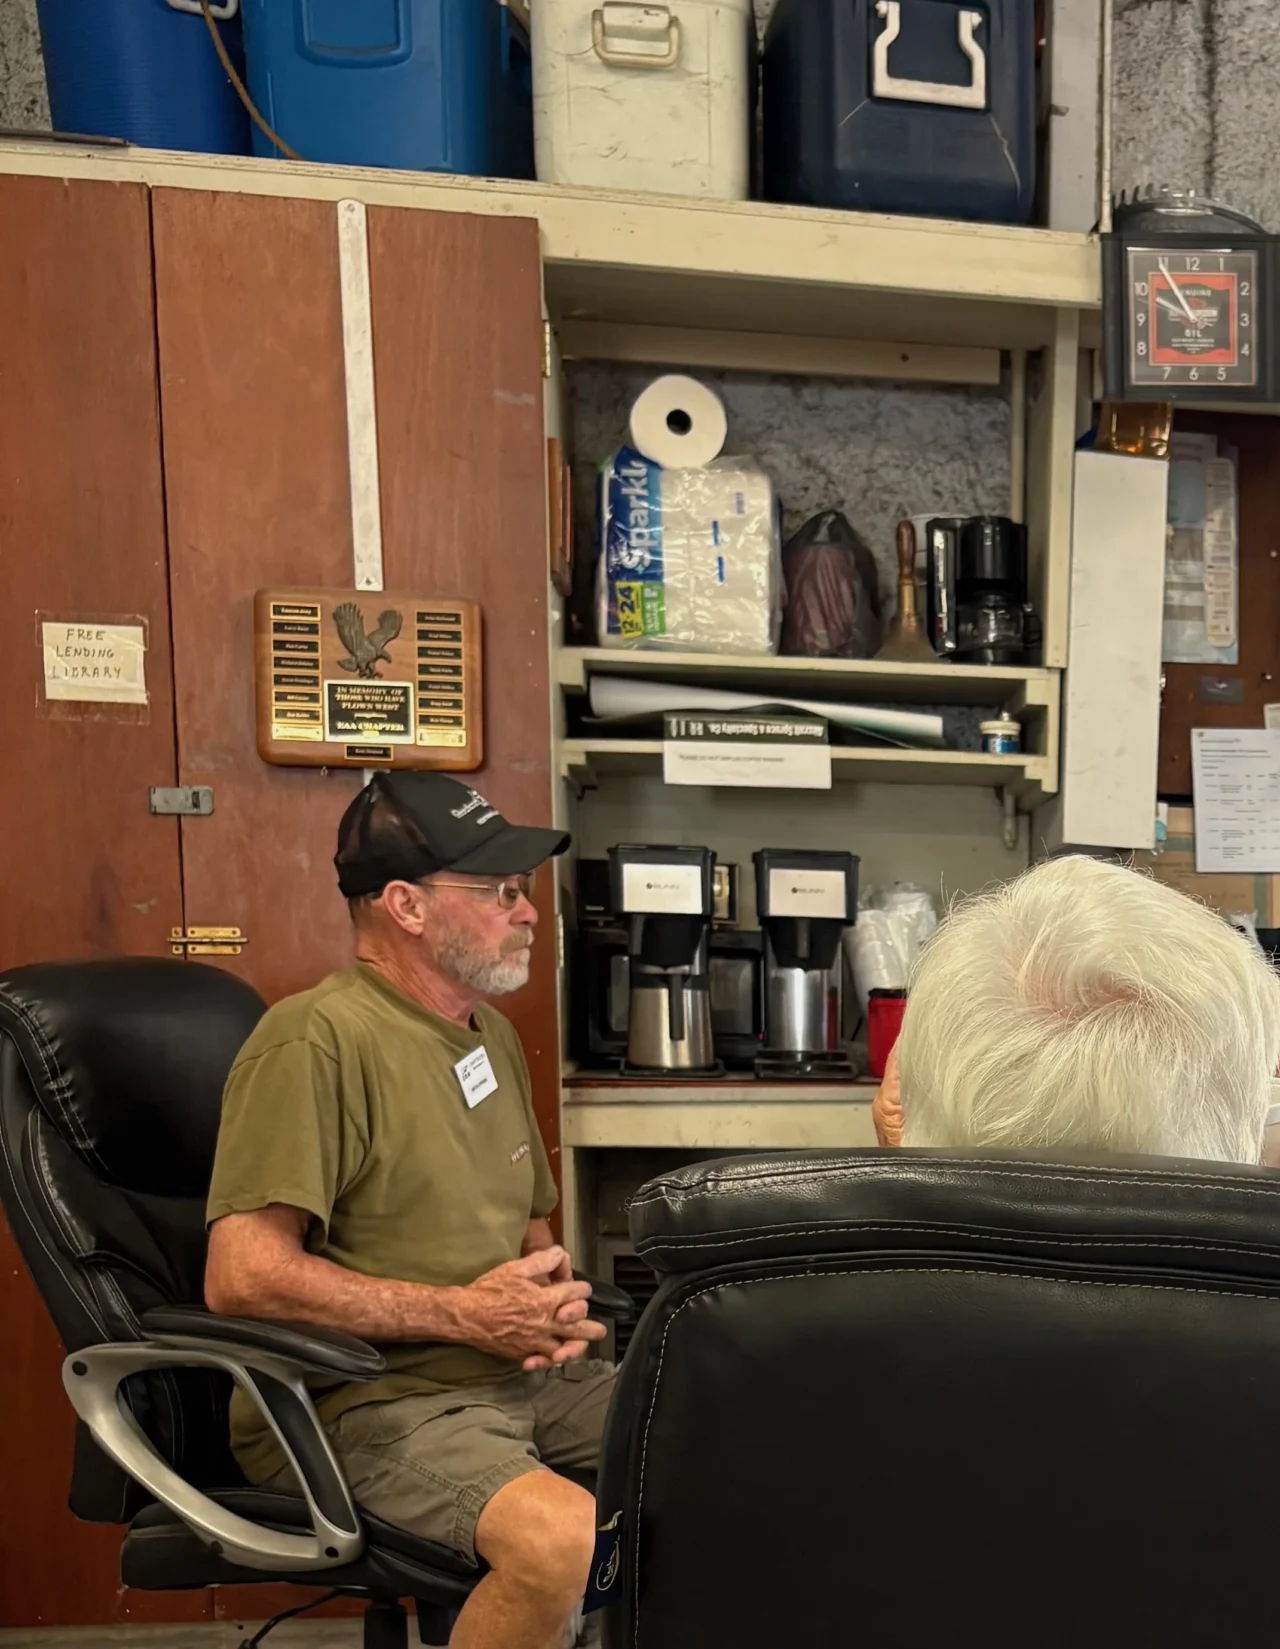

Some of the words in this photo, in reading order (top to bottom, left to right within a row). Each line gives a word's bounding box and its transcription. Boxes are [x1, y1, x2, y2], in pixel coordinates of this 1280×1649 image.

[1185, 257, 1200, 271] 12
[1219, 257, 1224, 271] 1
[1134, 282, 1148, 296] 10
[1240, 282, 1249, 295] 2
[1136, 313, 1145, 326] 9
[1240, 313, 1249, 326] 3
[1136, 341, 1147, 355] 8
[1241, 344, 1249, 356] 4
[1163, 366, 1172, 380] 7
[1189, 367, 1198, 380] 6
[1217, 367, 1226, 380] 5
[66, 628, 106, 641] FREE
[56, 645, 115, 658] LENDING
[48, 665, 122, 679] LIBRARY
[337, 686, 348, 694] IN
